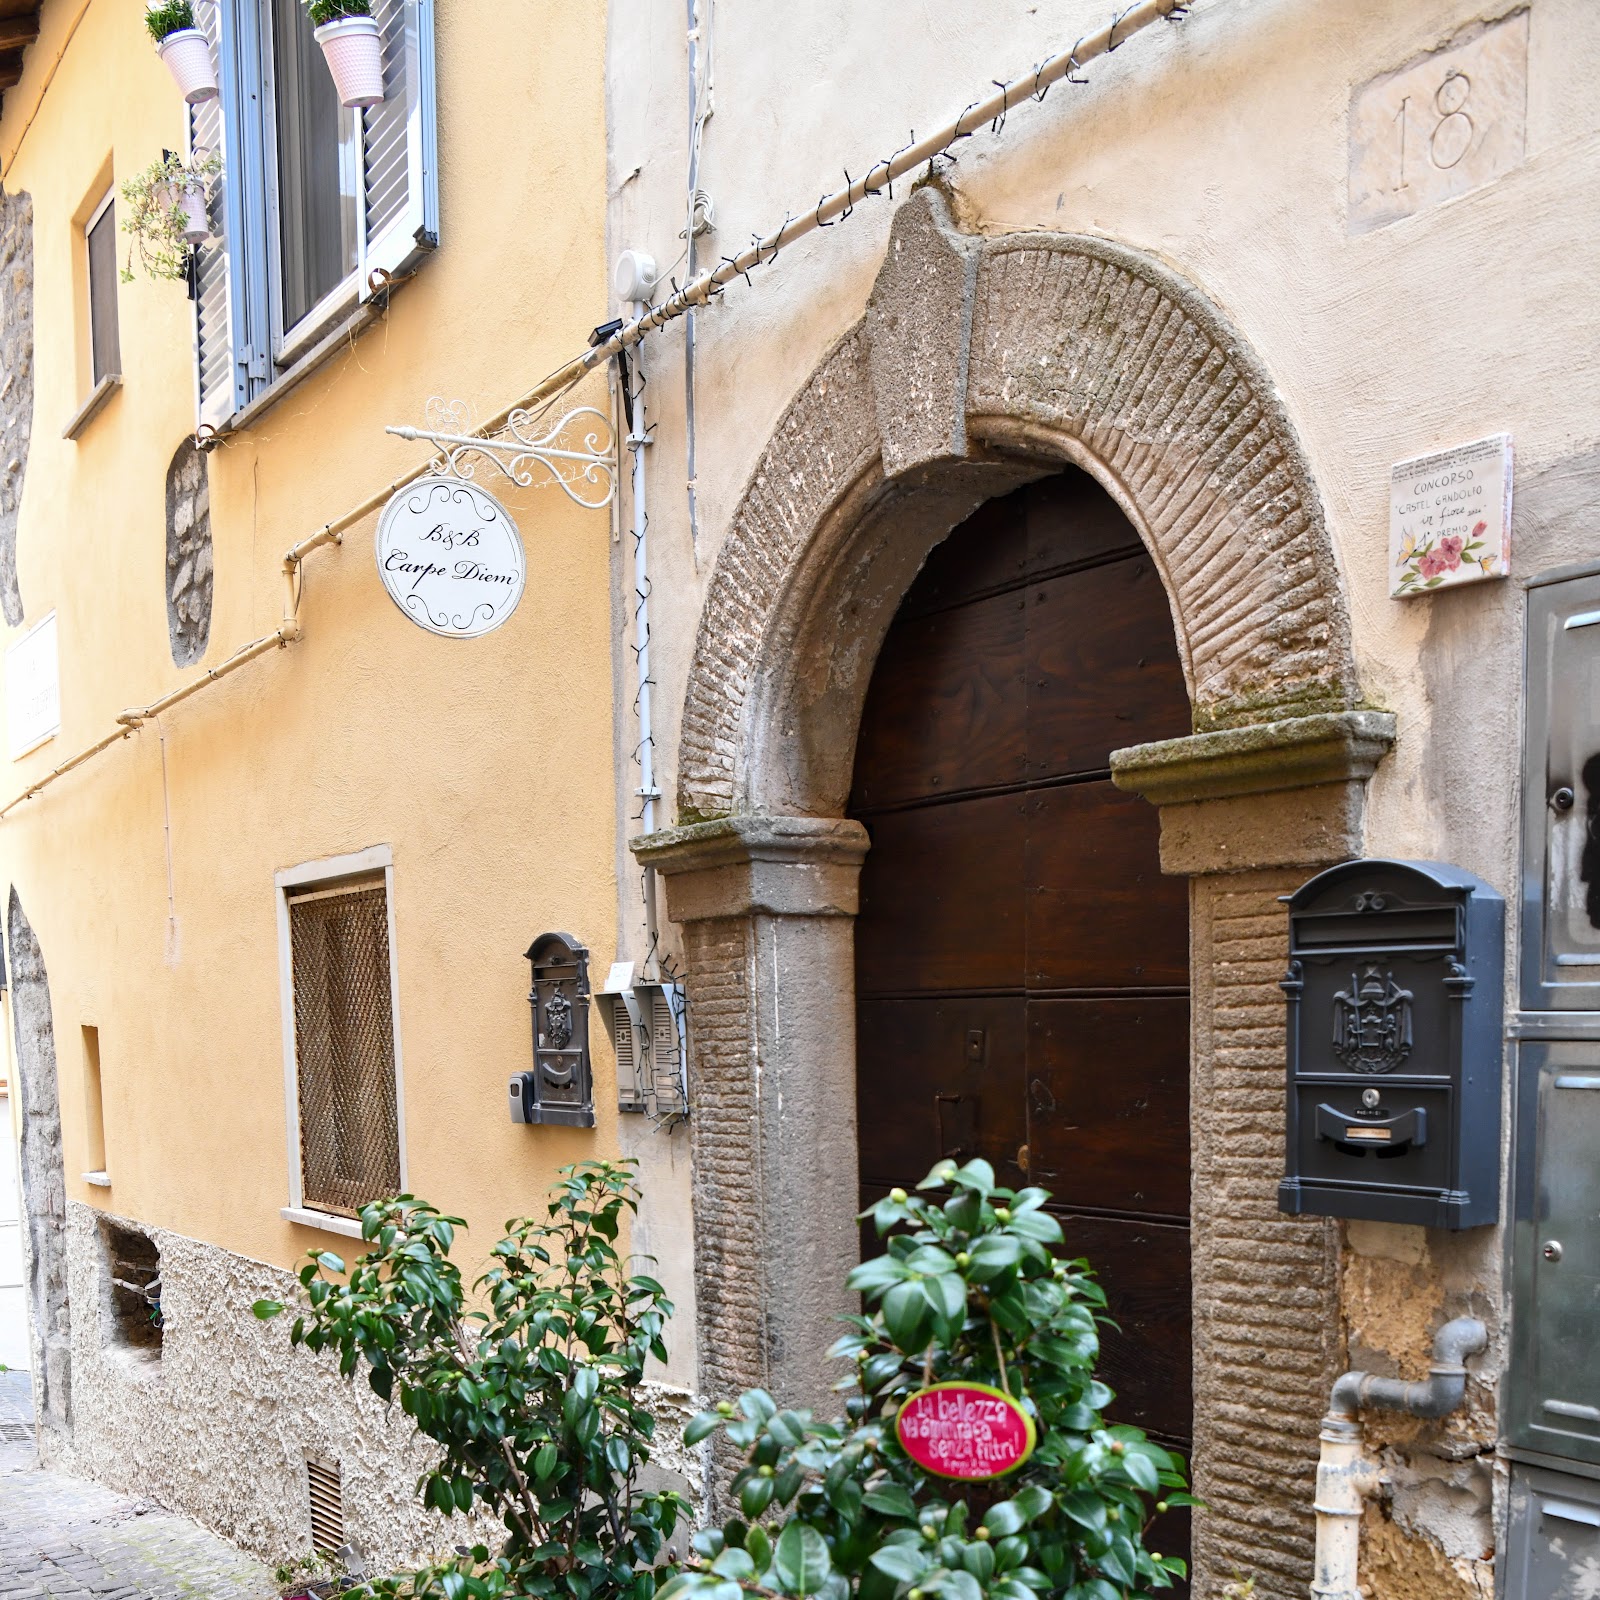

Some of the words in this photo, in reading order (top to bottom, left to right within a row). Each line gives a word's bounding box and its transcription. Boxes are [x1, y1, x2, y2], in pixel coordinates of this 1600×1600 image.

[1392, 73, 1474, 191] 18
[1413, 469, 1474, 496] CONCORSO
[1435, 485, 1482, 506] GANDOLFO
[1421, 514, 1434, 526] in
[1439, 506, 1466, 527] fiore
[418, 522, 486, 551] B&B
[1437, 525, 1469, 539] PREMIO
[384, 548, 447, 590] Carpe
[451, 560, 520, 585] Diem
